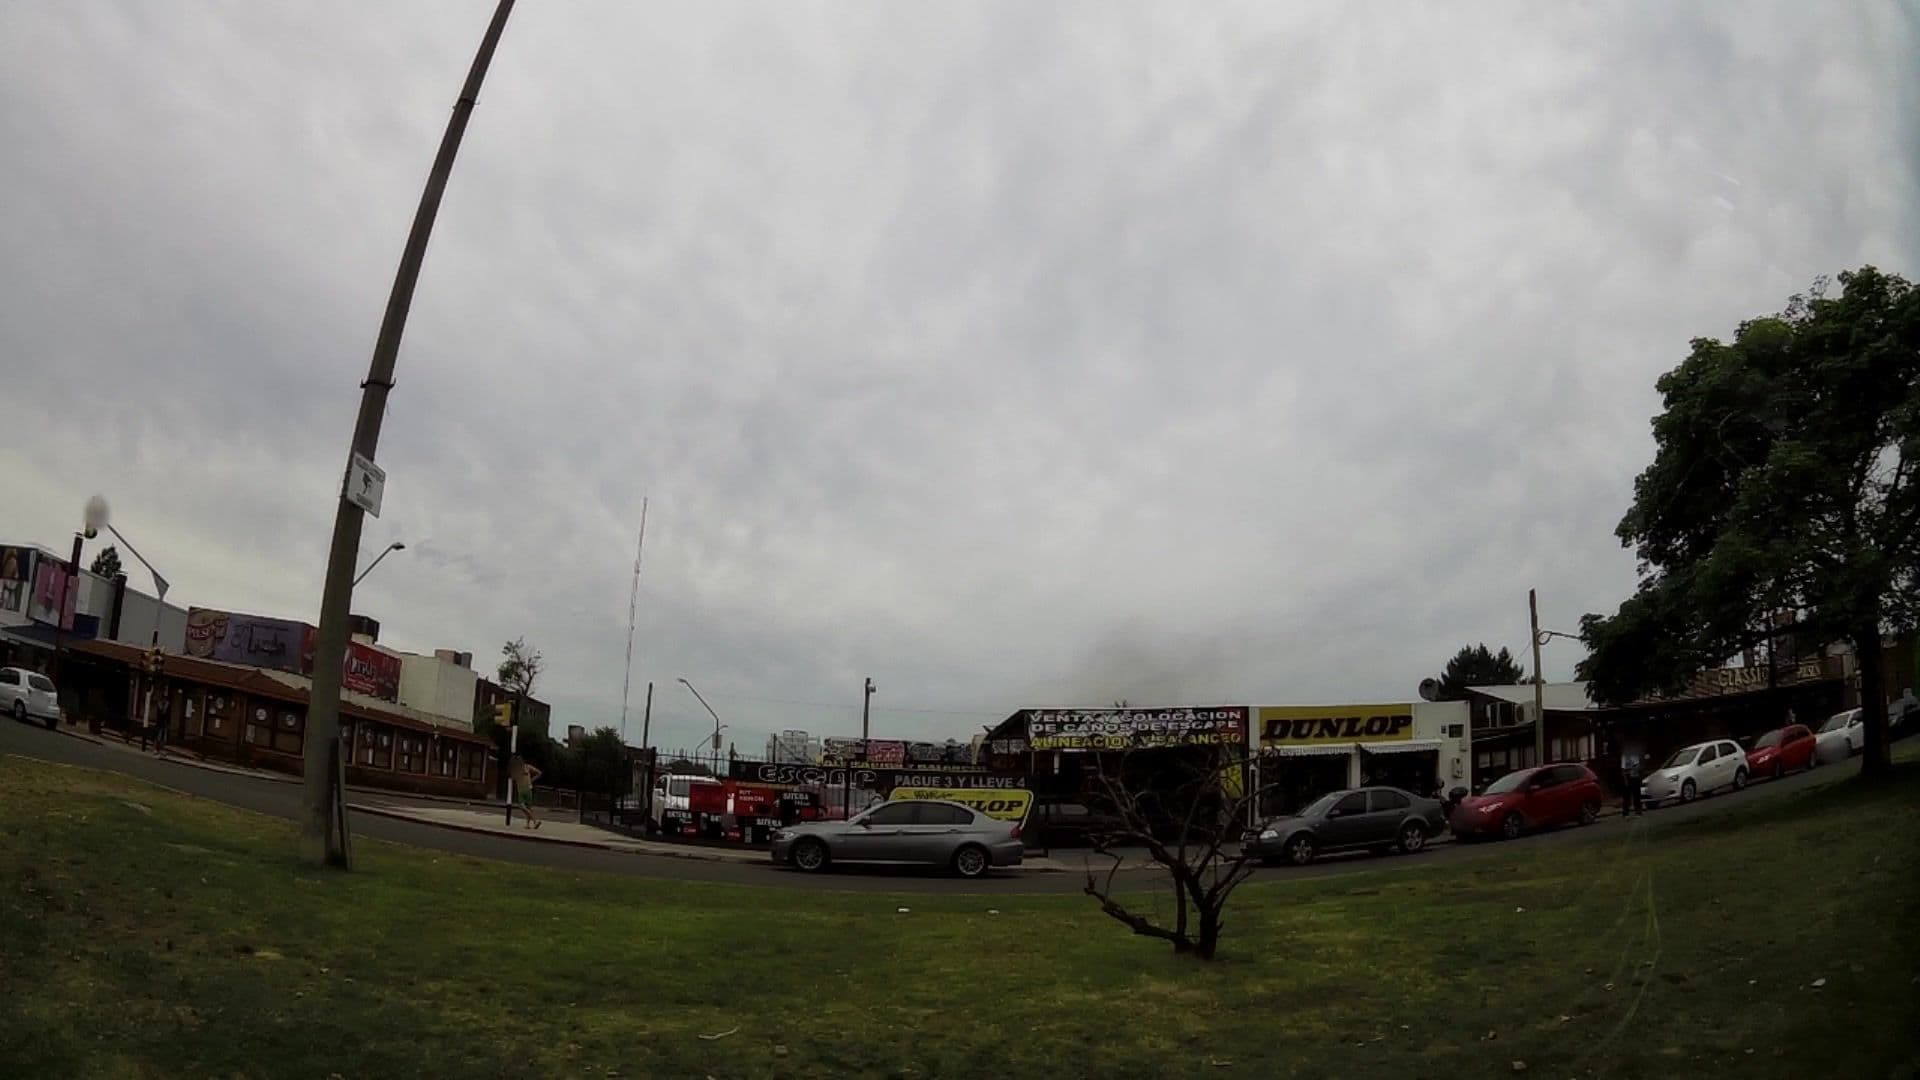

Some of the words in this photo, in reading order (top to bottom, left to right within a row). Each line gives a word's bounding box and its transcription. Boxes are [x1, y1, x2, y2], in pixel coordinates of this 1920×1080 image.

[1031, 713, 1095, 723] VENTA
[1120, 711, 1241, 722] COLOCACION
[1031, 723, 1057, 733] DE
[1138, 722, 1161, 731] DE
[1168, 720, 1240, 731] ESCAPE
[1260, 715, 1413, 740] DUNLOP
[1031, 735, 1134, 748] ALINEACION
[894, 775, 942, 787] PAGUE
[945, 776, 953, 787] 3
[958, 776, 967, 788] Y
[971, 777, 1013, 788] LLEVE
[1016, 777, 1025, 788] 4
